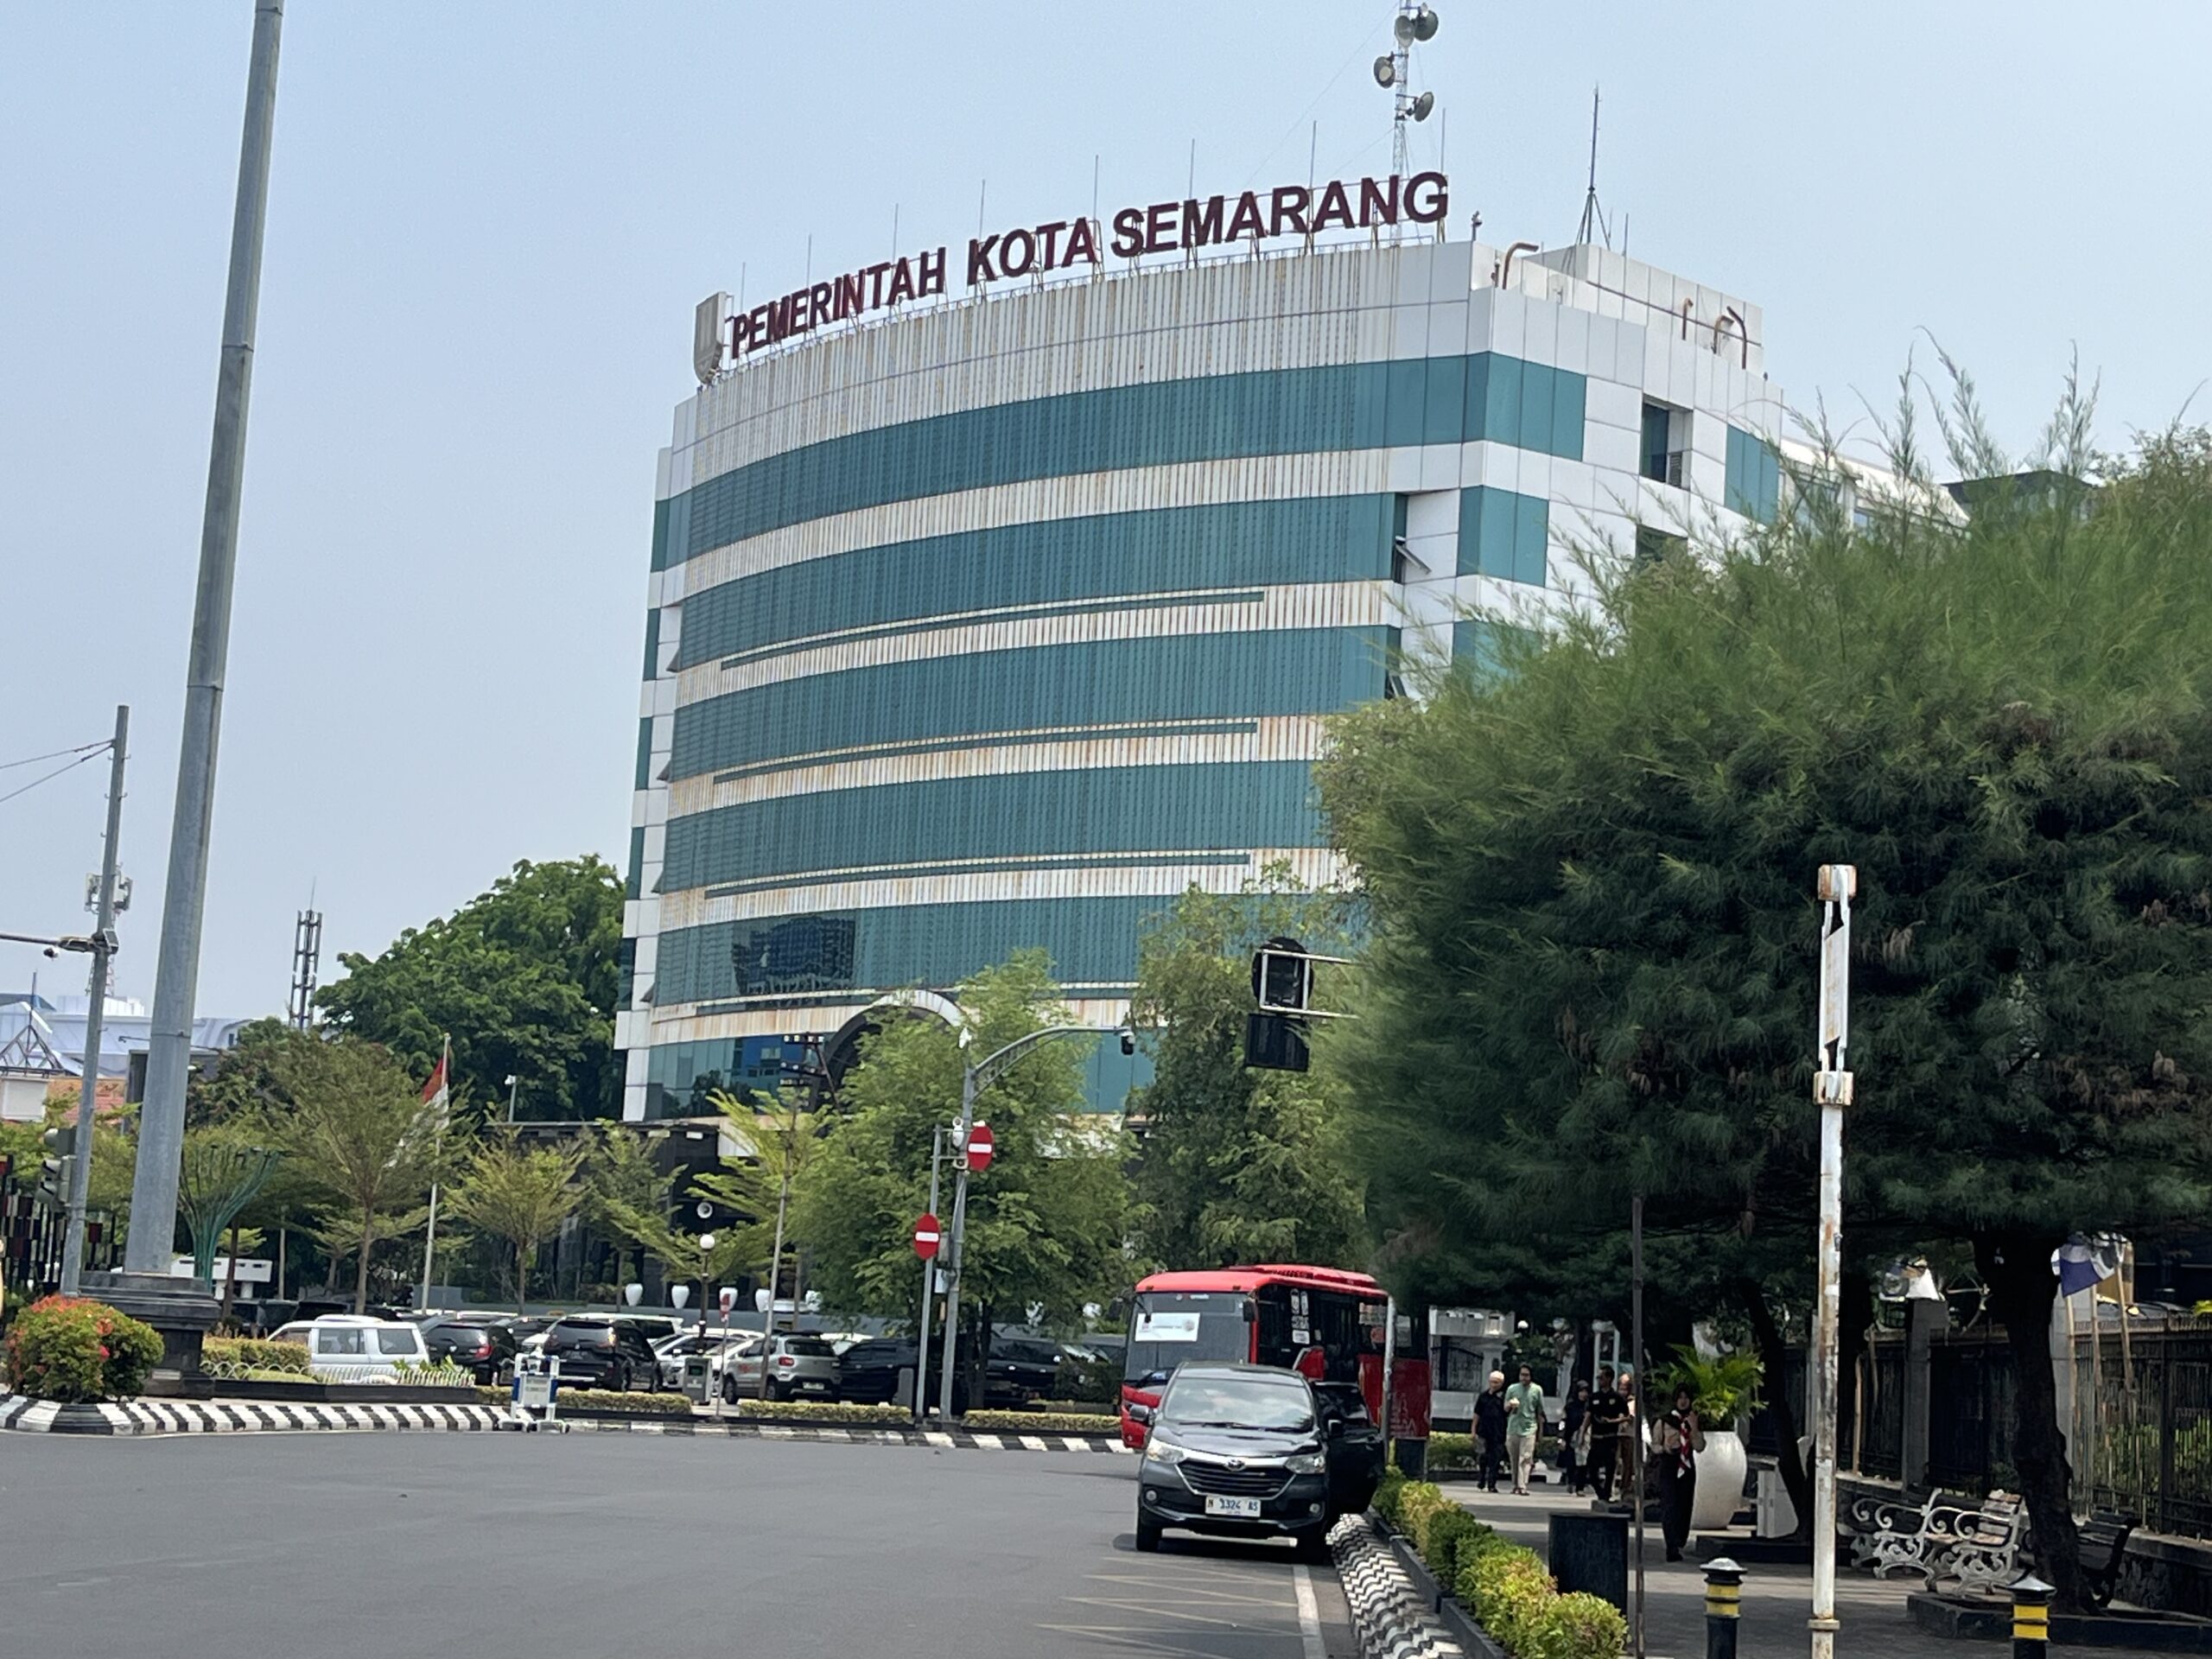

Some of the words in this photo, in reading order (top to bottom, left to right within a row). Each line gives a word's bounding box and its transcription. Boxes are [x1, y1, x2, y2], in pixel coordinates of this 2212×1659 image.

[731, 247, 946, 359] PEMERINTAH
[967, 217, 1097, 285] KOTA
[1111, 172, 1448, 257] SEMARANG
